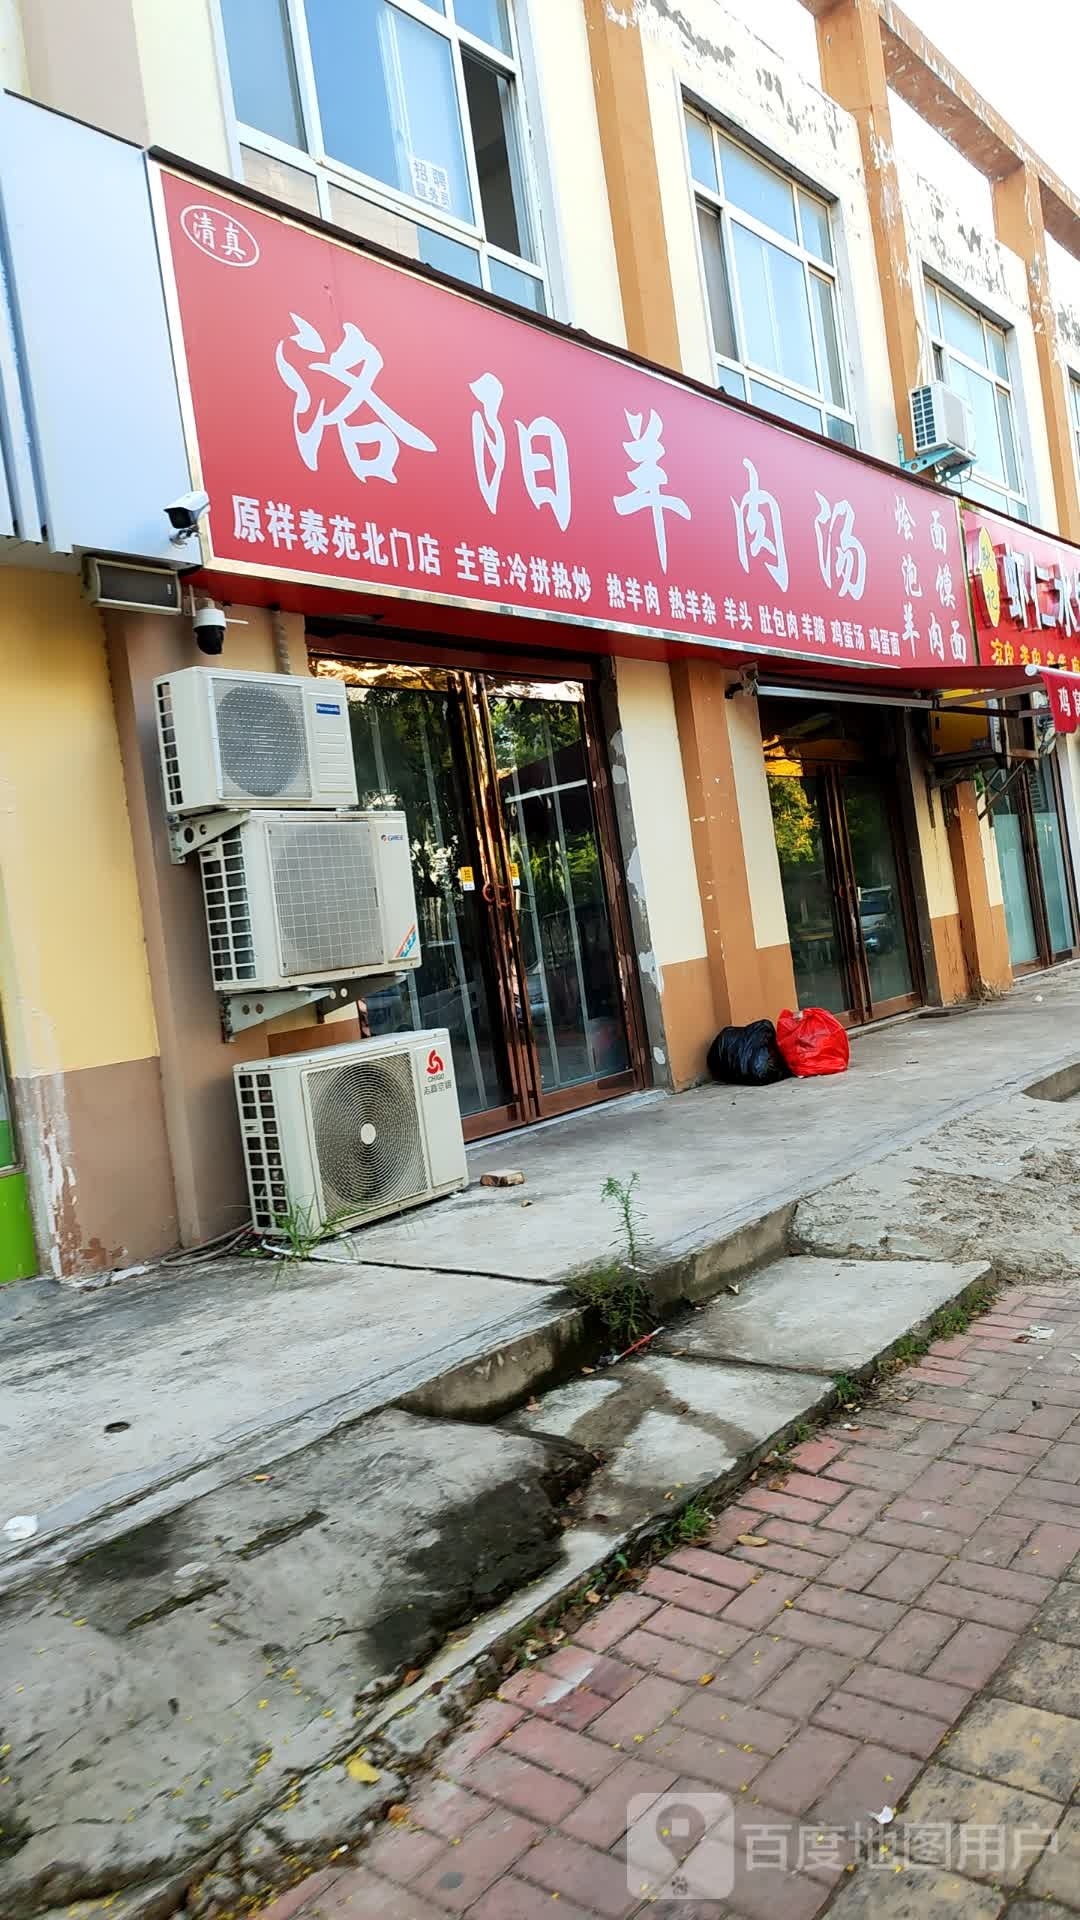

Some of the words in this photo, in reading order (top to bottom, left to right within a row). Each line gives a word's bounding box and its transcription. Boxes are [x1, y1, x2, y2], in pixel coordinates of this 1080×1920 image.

[192, 212, 248, 261] 清真
[275, 311, 867, 601] 洛阳羊肉汤
[894, 494, 947, 555] 烩面
[231, 494, 442, 576] 原祥泰苑北门店
[606, 572, 661, 616] 热羊肉
[668, 585, 717, 625] 热羊杂
[724, 597, 753, 631] 羊头
[758, 605, 800, 641] 肚包肉
[830, 619, 865, 651] 鸡蛋汤
[869, 627, 901, 657] 鸡蛋面
[901, 553, 956, 610] 泡馍
[901, 602, 967, 664] 羊肉面
